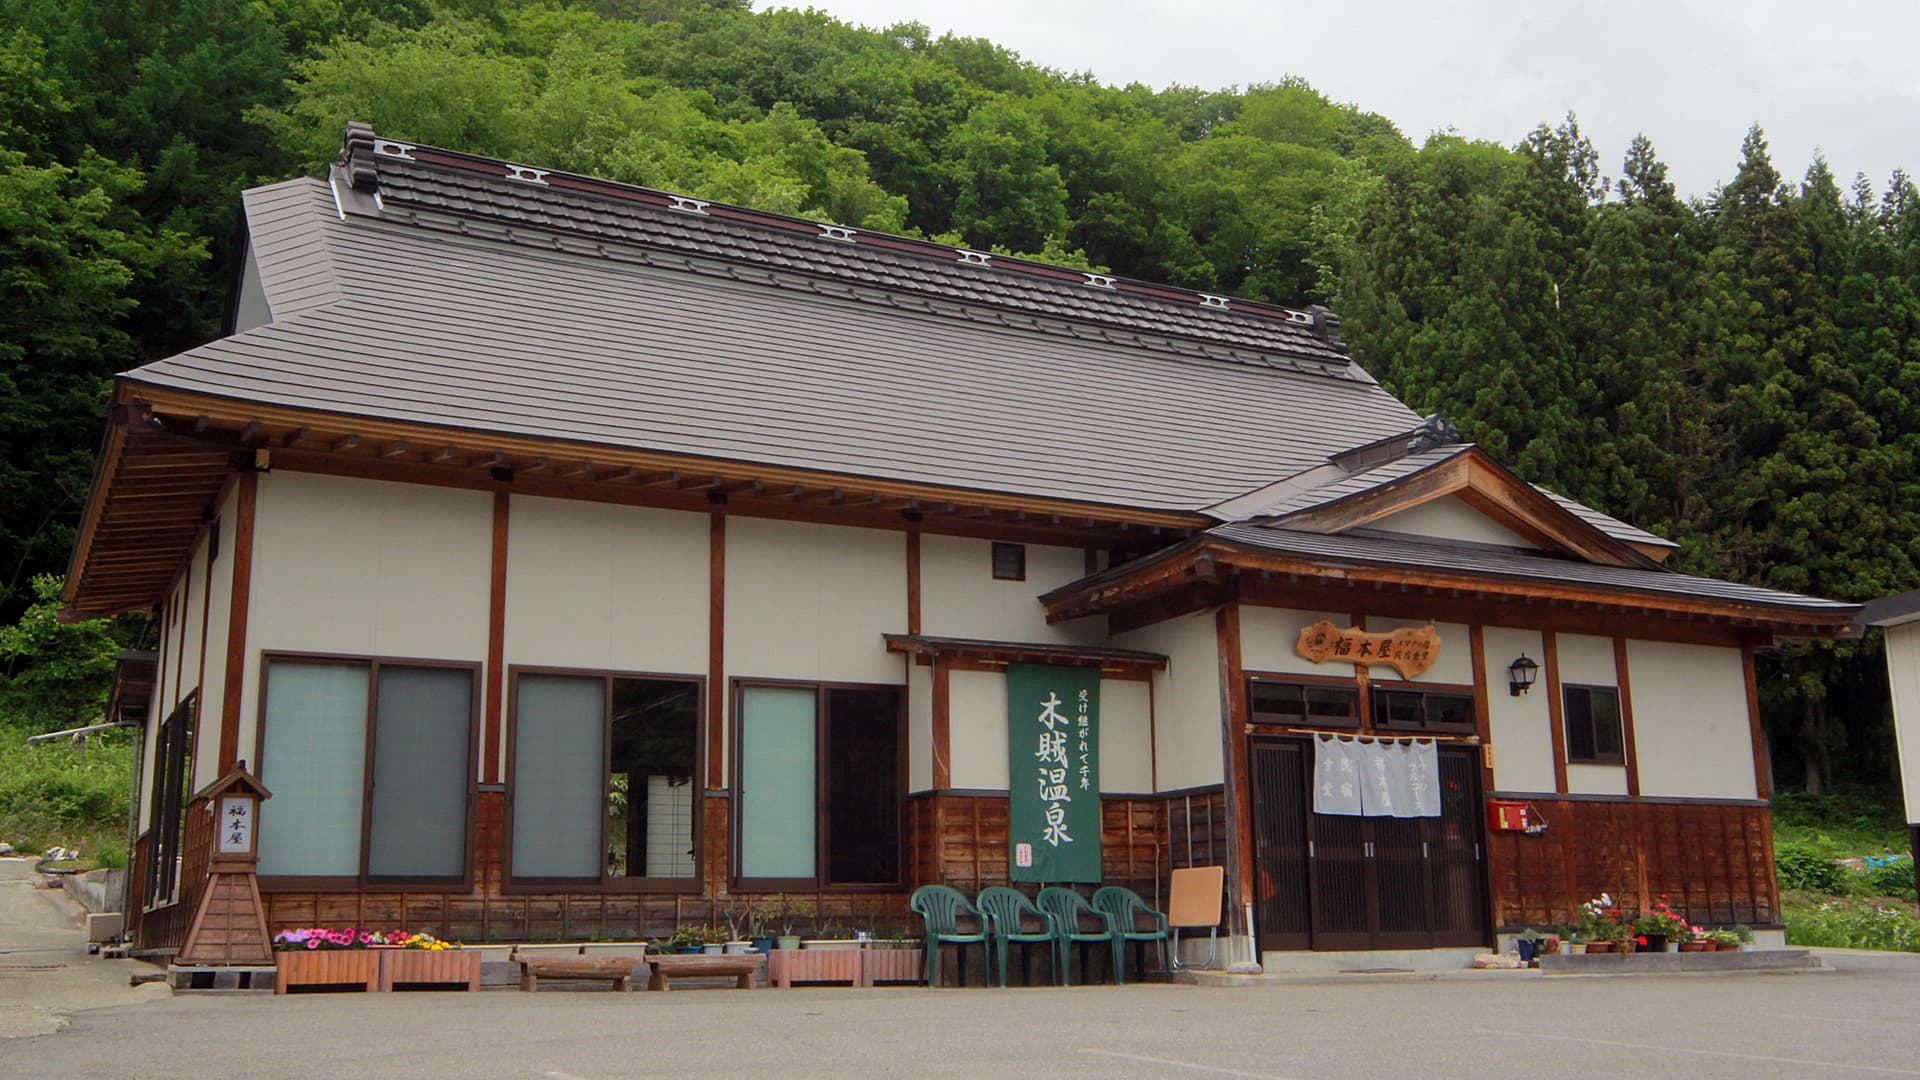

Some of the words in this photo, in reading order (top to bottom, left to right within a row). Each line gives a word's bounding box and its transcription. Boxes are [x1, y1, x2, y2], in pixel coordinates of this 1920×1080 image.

[1333, 636, 1393, 659] 福本屋
[1078, 689, 1091, 790] 受け継がれて千年
[1034, 691, 1074, 847] 木賊温泉
[1321, 757, 1334, 797] 食堂
[1341, 757, 1353, 798] 民宿
[1373, 755, 1392, 807] 福本屋
[225, 805, 246, 845] 福本屋
